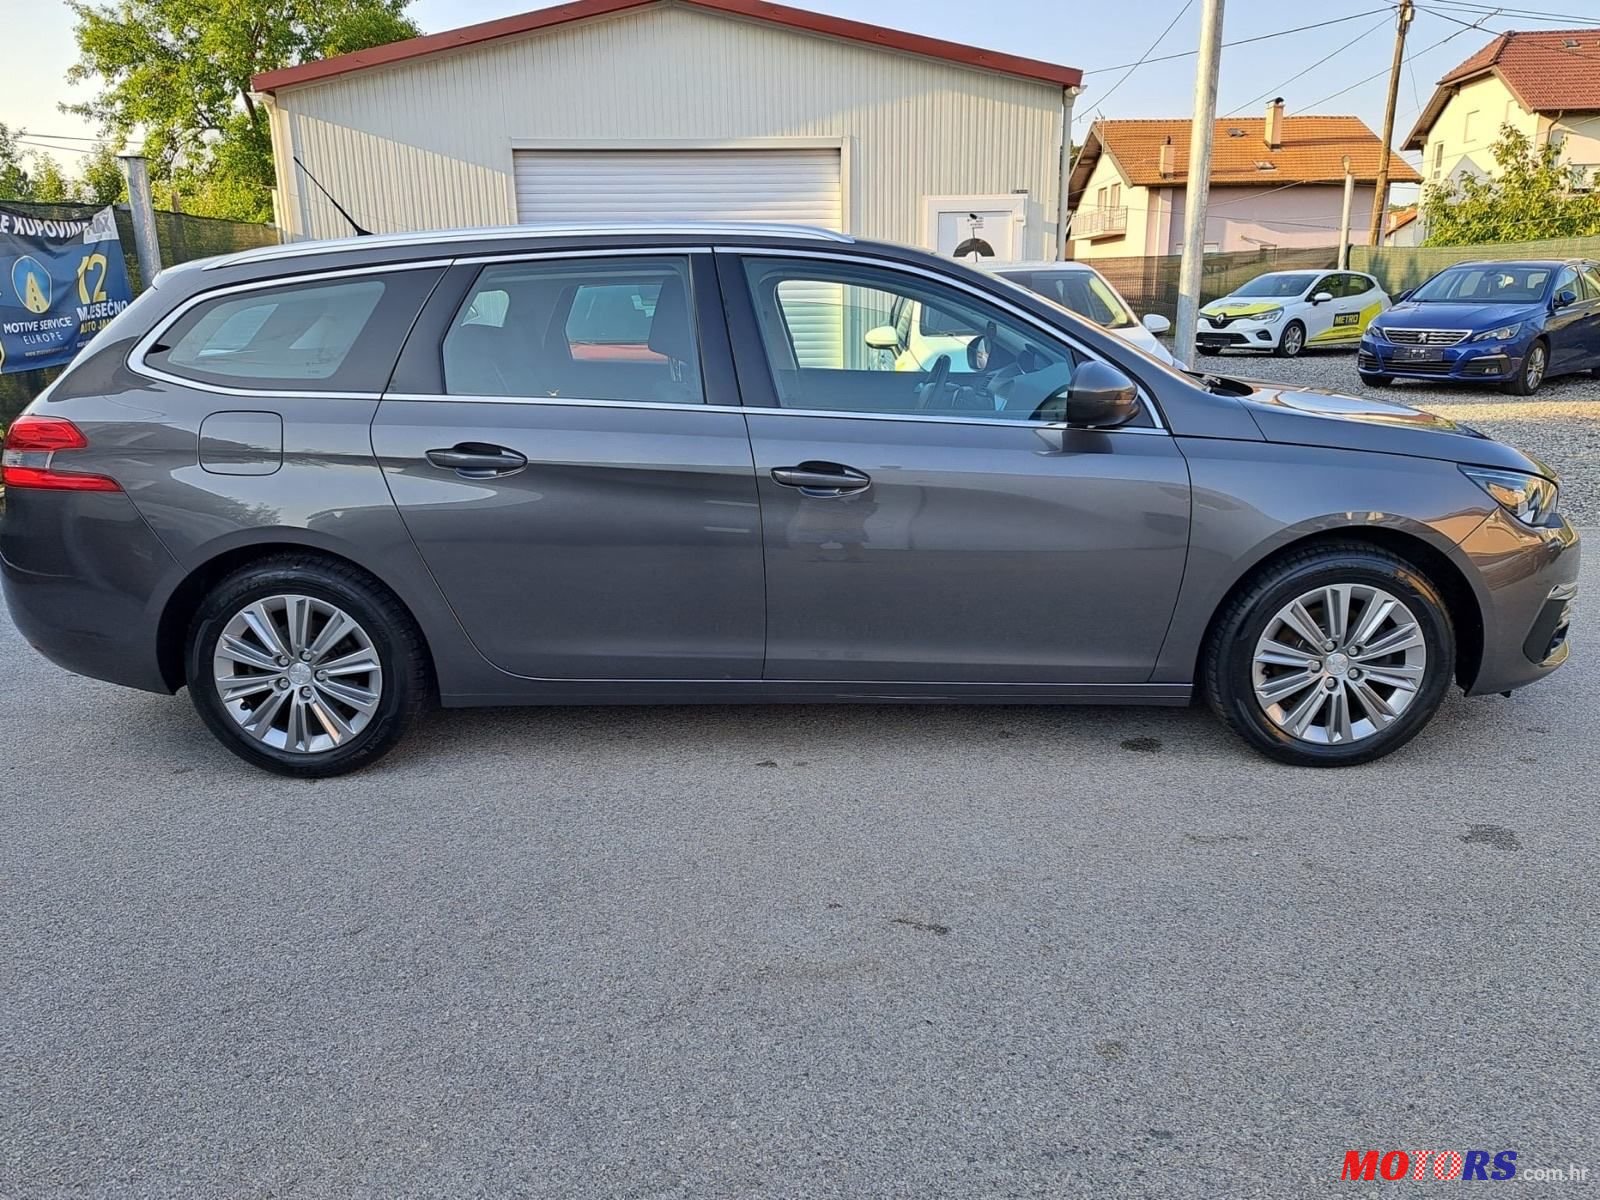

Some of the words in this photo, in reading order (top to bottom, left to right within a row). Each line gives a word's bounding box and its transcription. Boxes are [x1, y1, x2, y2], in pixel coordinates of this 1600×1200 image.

[77, 253, 107, 305] 12
[3, 320, 38, 334] MOTIVE
[39, 316, 73, 330] SERVICE
[1335, 314, 1358, 325] METRO
[23, 331, 63, 345] EUROPE
